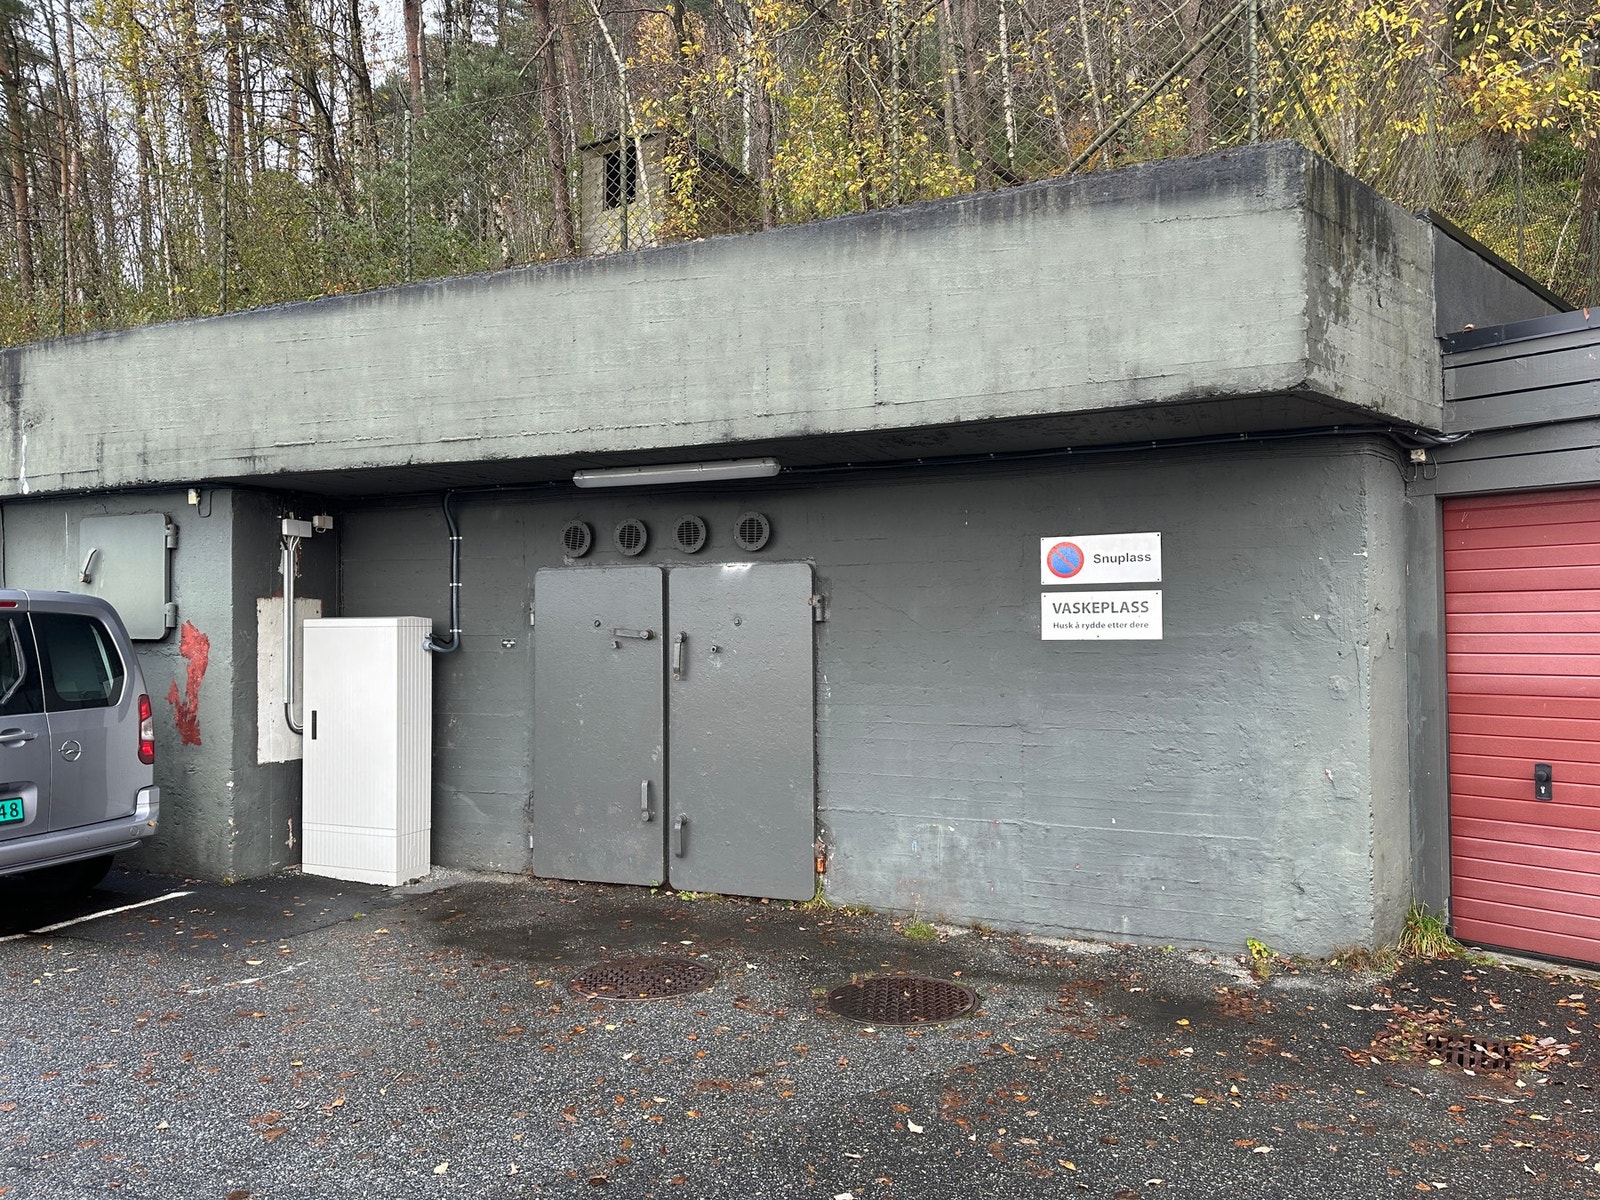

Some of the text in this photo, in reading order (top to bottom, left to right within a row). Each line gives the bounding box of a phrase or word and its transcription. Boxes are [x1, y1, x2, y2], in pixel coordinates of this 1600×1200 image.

[1093, 552, 1152, 565] Snuplass
[1052, 601, 1149, 614] VASKEPLASS
[1053, 621, 1074, 629] Husk
[1081, 621, 1106, 630] rydde
[1107, 621, 1127, 629] etter
[1129, 621, 1149, 629] dere
[0, 802, 19, 819] 48
